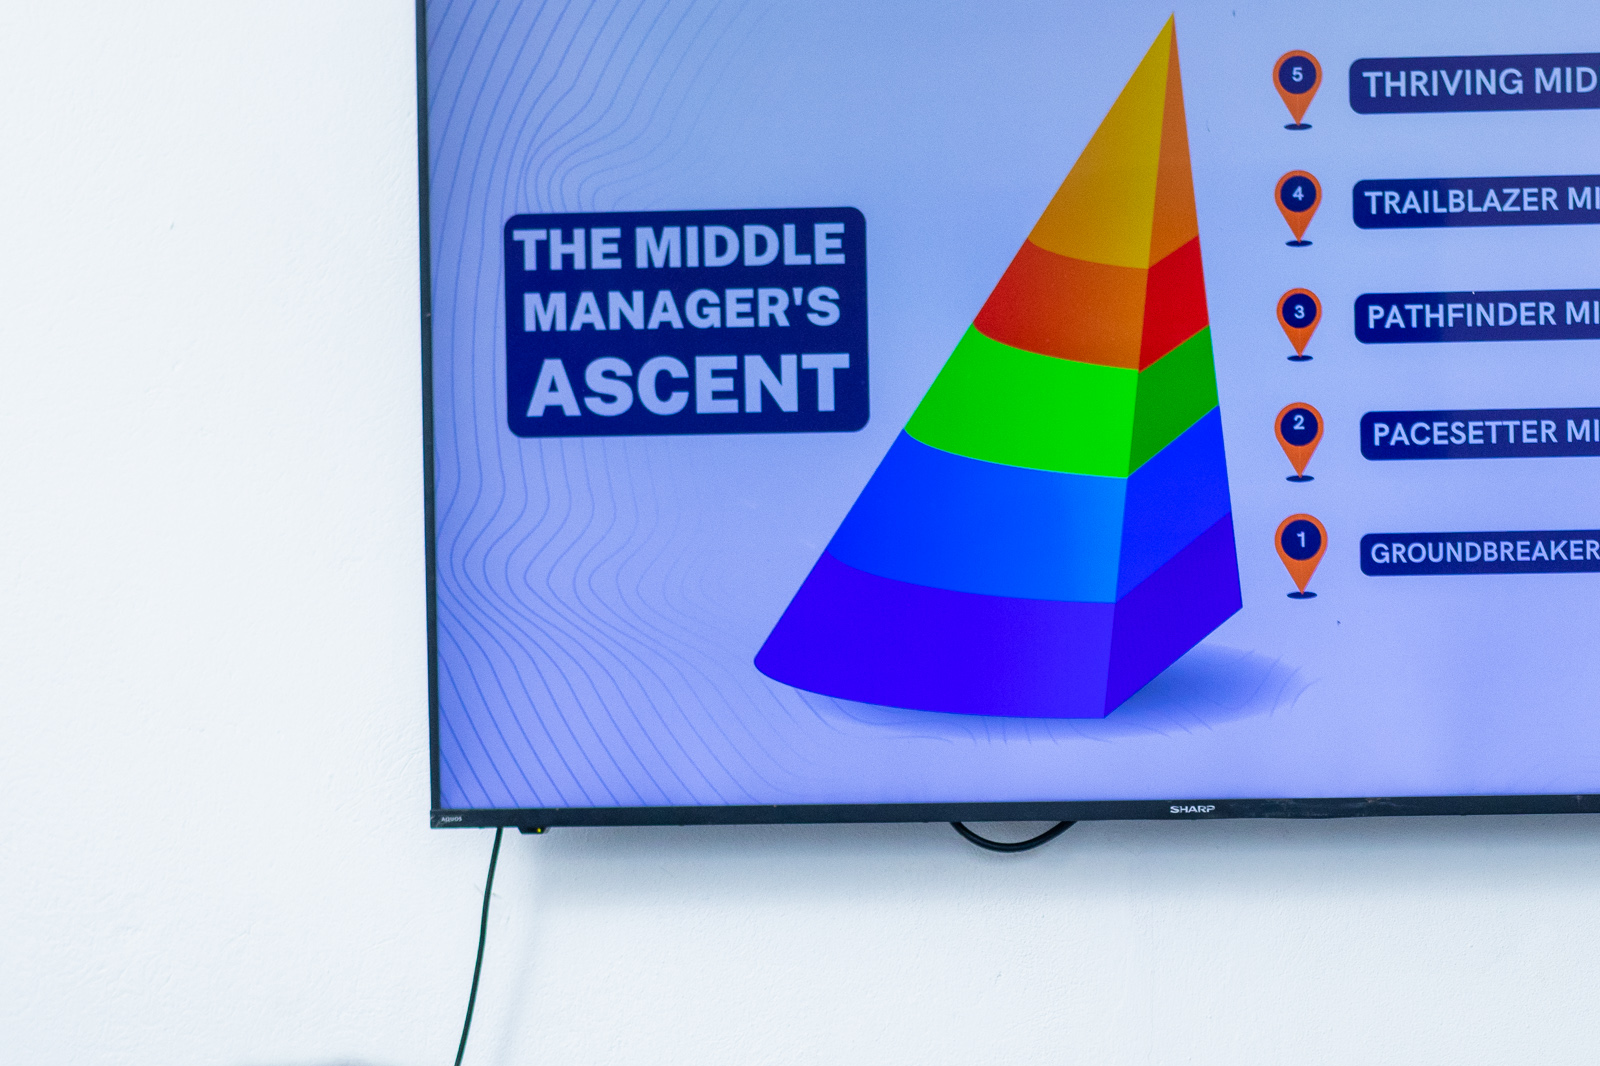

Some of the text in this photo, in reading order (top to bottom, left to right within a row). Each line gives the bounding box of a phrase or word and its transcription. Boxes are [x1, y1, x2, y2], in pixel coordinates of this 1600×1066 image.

[1292, 67, 1304, 82] 5
[1362, 68, 1524, 98] THRIVING
[1292, 186, 1304, 201] 4
[1364, 188, 1559, 215] TRAILBLAZER
[512, 222, 846, 271] THE MIDDLE
[523, 286, 841, 332] MANAGER'S
[1294, 305, 1305, 319] 3
[1368, 302, 1557, 329] PATHFINDER
[526, 352, 850, 417] ASCENT
[1293, 416, 1305, 430] 2
[1374, 420, 1558, 446] PACESETTER
[1297, 532, 1306, 548] 1
[1169, 805, 1216, 814] SHARP
